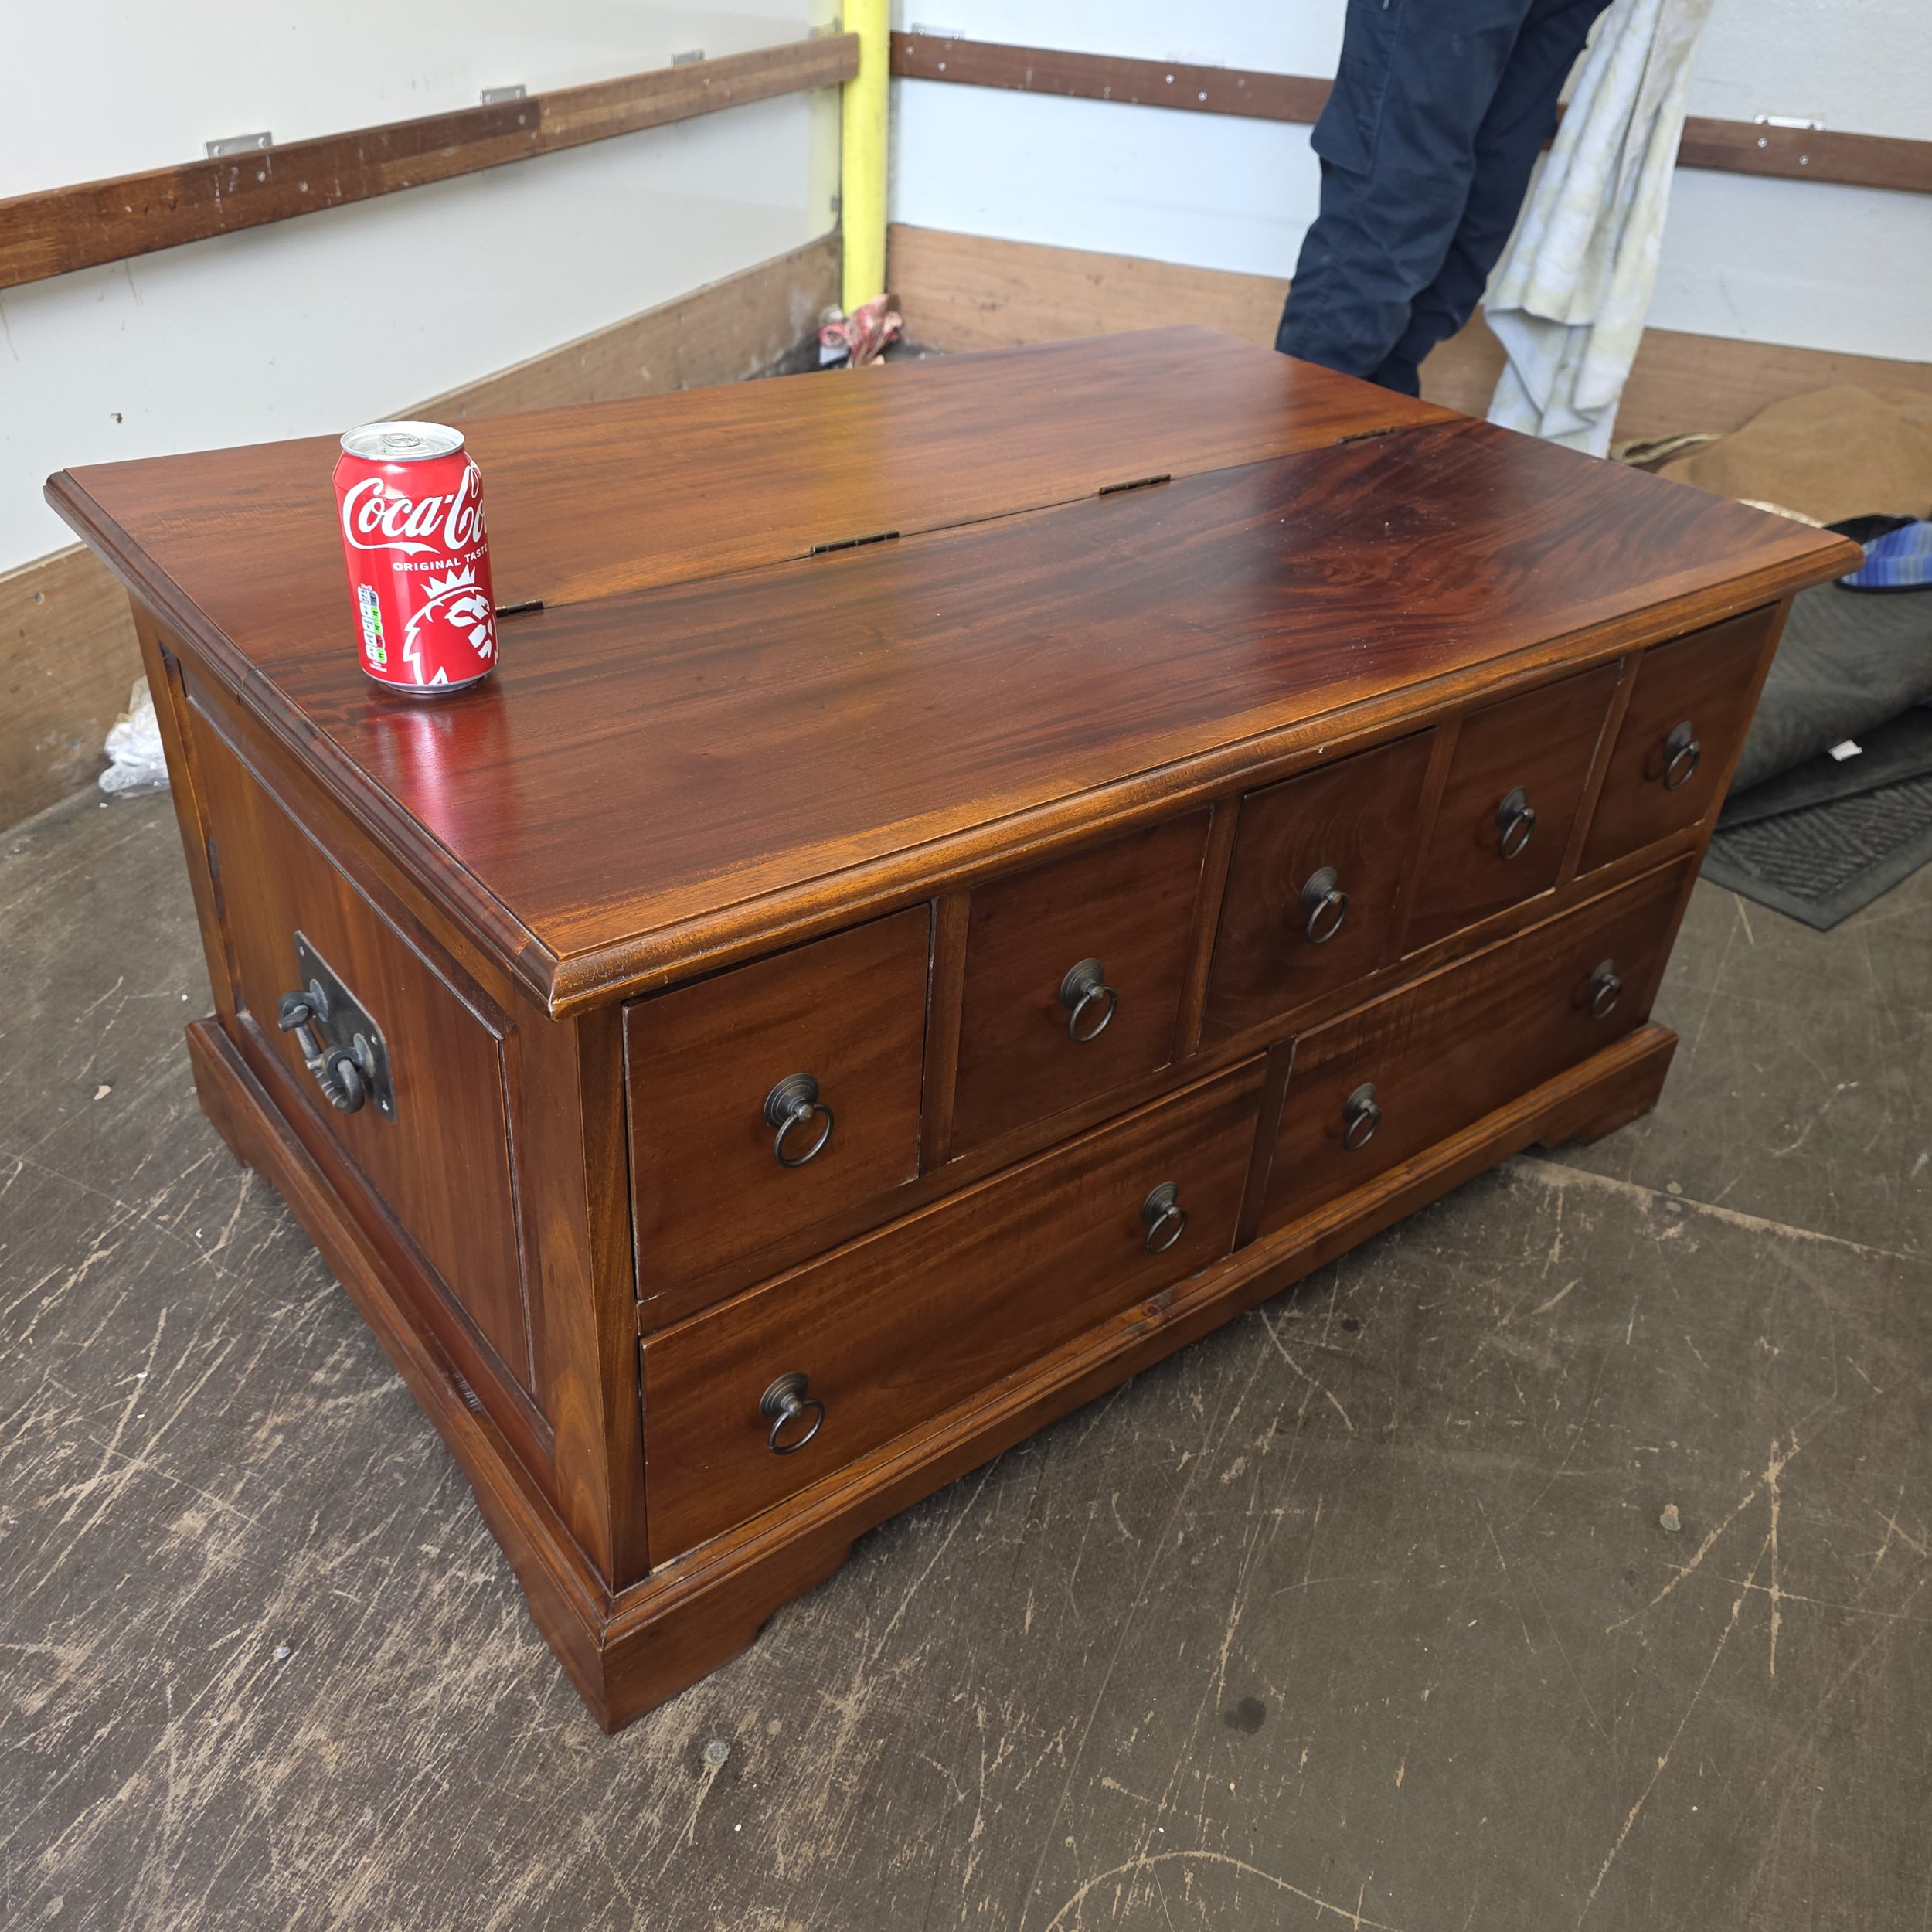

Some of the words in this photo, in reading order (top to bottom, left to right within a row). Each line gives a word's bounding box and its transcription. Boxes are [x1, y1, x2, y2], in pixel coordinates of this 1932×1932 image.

[342, 461, 488, 556] Coca-Co
[393, 557, 462, 572] ORIGINAL
[464, 543, 488, 563] TASTE
